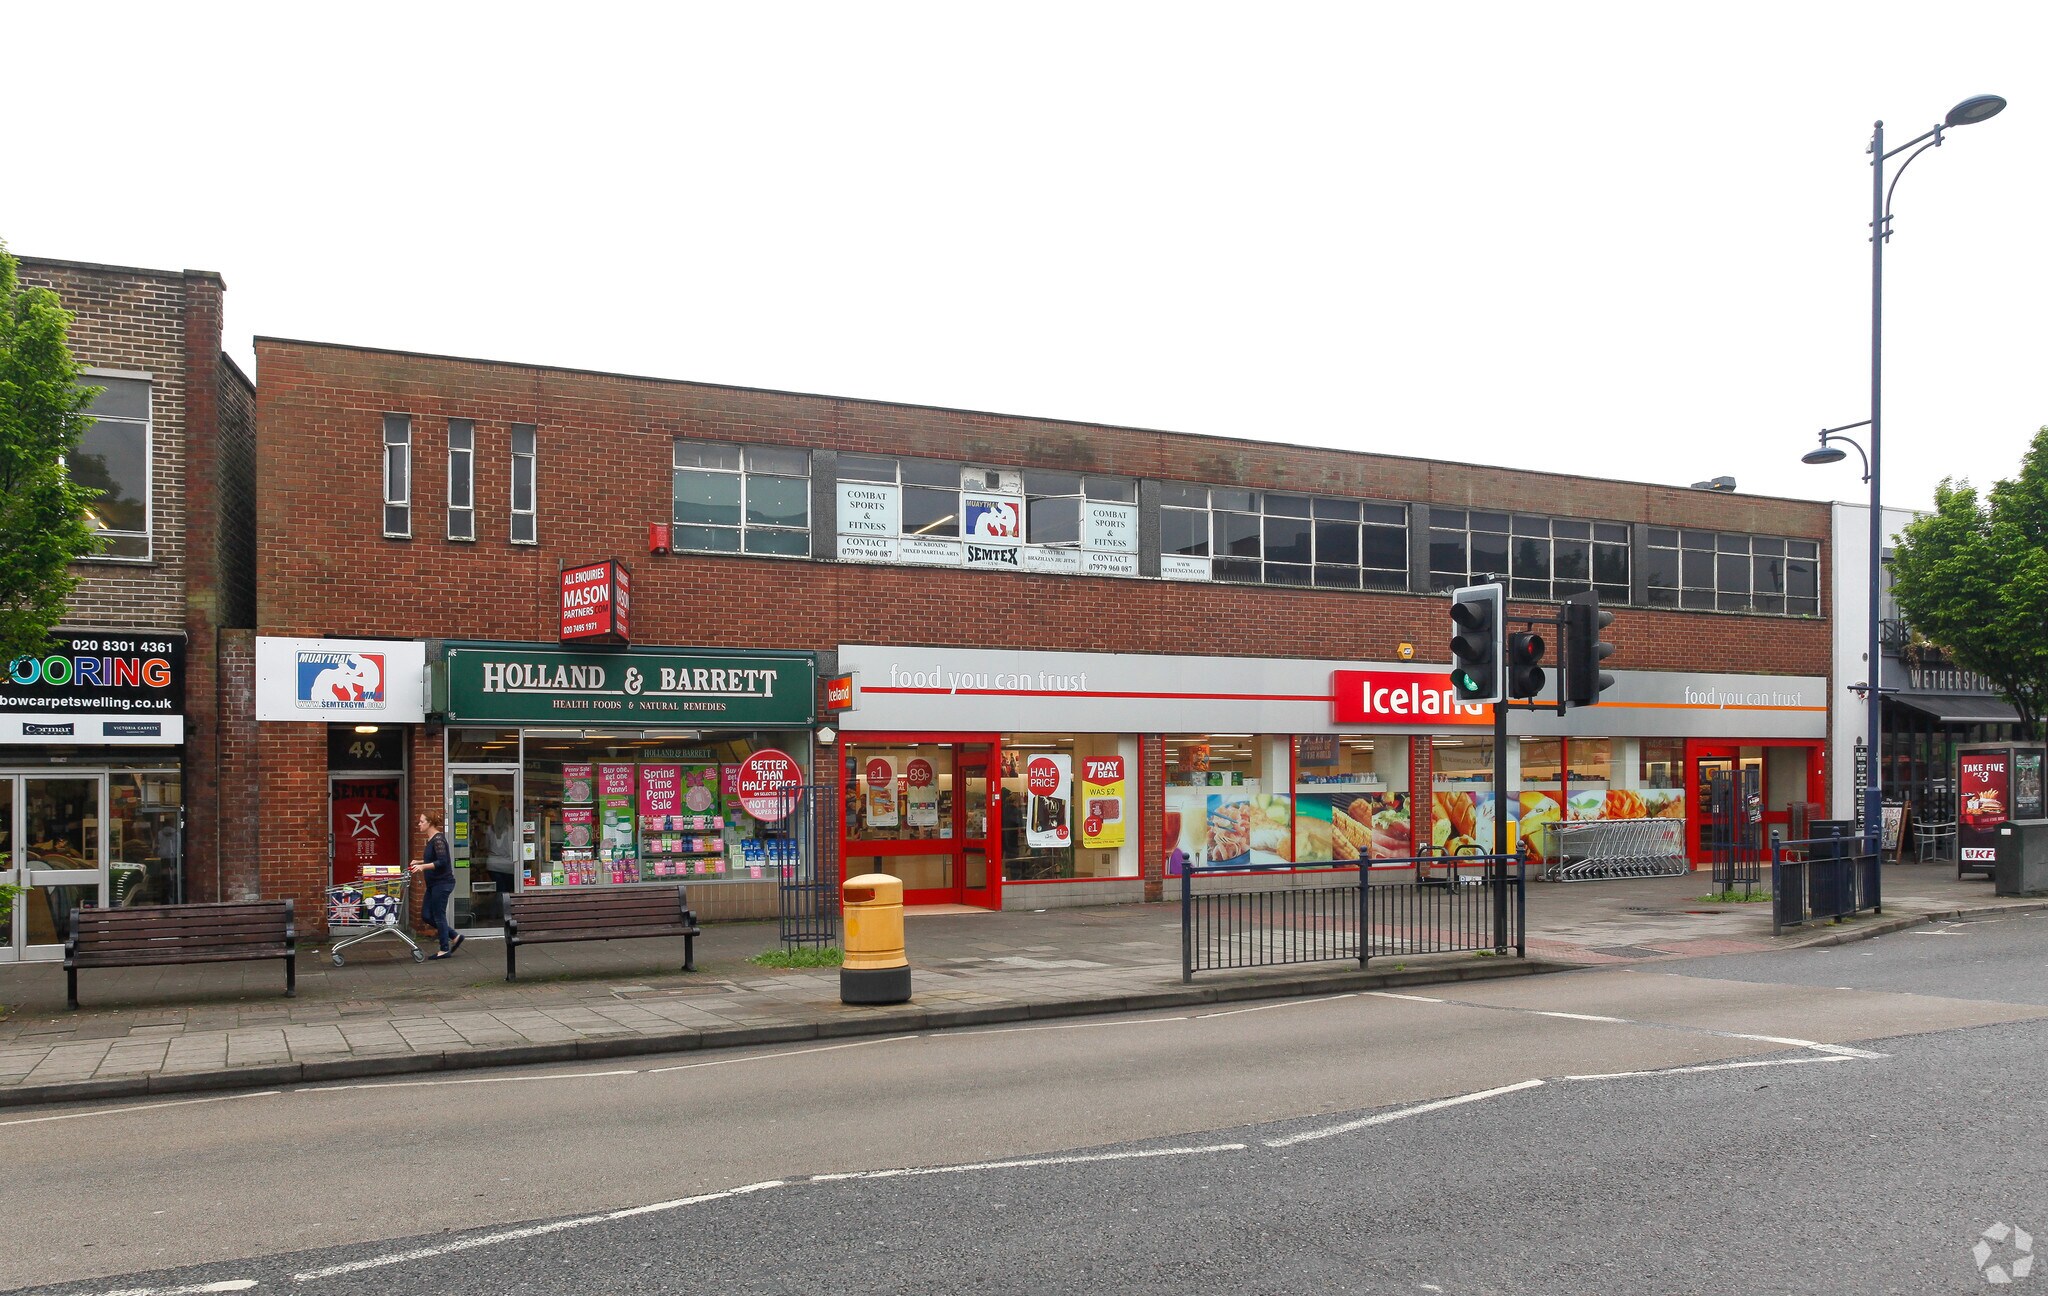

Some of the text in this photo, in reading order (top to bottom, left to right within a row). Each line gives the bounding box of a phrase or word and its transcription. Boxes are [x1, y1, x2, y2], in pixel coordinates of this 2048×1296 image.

[848, 490, 887, 500] COMBAT
[850, 501, 885, 510] SPORTS
[966, 500, 999, 508] MUAYTHAI
[1093, 509, 1127, 518] COMBAT
[849, 521, 886, 530] FITNESS
[1095, 519, 1126, 528] SPORTS
[846, 538, 888, 548] CONTACT
[1094, 539, 1127, 547] FITNESS
[968, 545, 1018, 566] SEMTEX
[1092, 554, 1128, 563] CONTACT
[564, 574, 575, 585] ALL
[576, 568, 604, 583] ENQUIRIES
[564, 584, 609, 608] MASON
[72, 640, 172, 652] 020 8301 4361
[299, 653, 349, 664] MUAYTHAI
[2, 655, 171, 687] OORING
[483, 663, 778, 698] HOLLAND & BARRETT
[890, 663, 1088, 695] food you can trust
[1911, 670, 1999, 690] WETHERSPO
[828, 685, 849, 702] Iceland
[1685, 686, 1802, 710] food you can trust
[553, 700, 726, 711] HEALTH FOODS & NATURAL REMEDIES
[751, 760, 788, 770] BETTER
[1087, 762, 1119, 778] 7 DAY
[1963, 764, 2004, 773] TAKE FIVE
[644, 768, 675, 780] Spring
[756, 771, 783, 780] THAN
[871, 766, 884, 779] £1
[910, 768, 929, 780] 89p
[1030, 768, 1056, 777] HALF
[1978, 772, 1989, 782] £3
[648, 780, 672, 788] Time
[742, 781, 767, 790] HALF
[770, 780, 797, 790] PRICE
[1030, 779, 1055, 787] PRICE
[333, 782, 398, 799] SEMTEX
[646, 790, 675, 800] Penny
[651, 800, 672, 810] Sale
[749, 800, 766, 808] NOT
[1088, 822, 1097, 832] £1
[1975, 850, 1995, 858] KF
